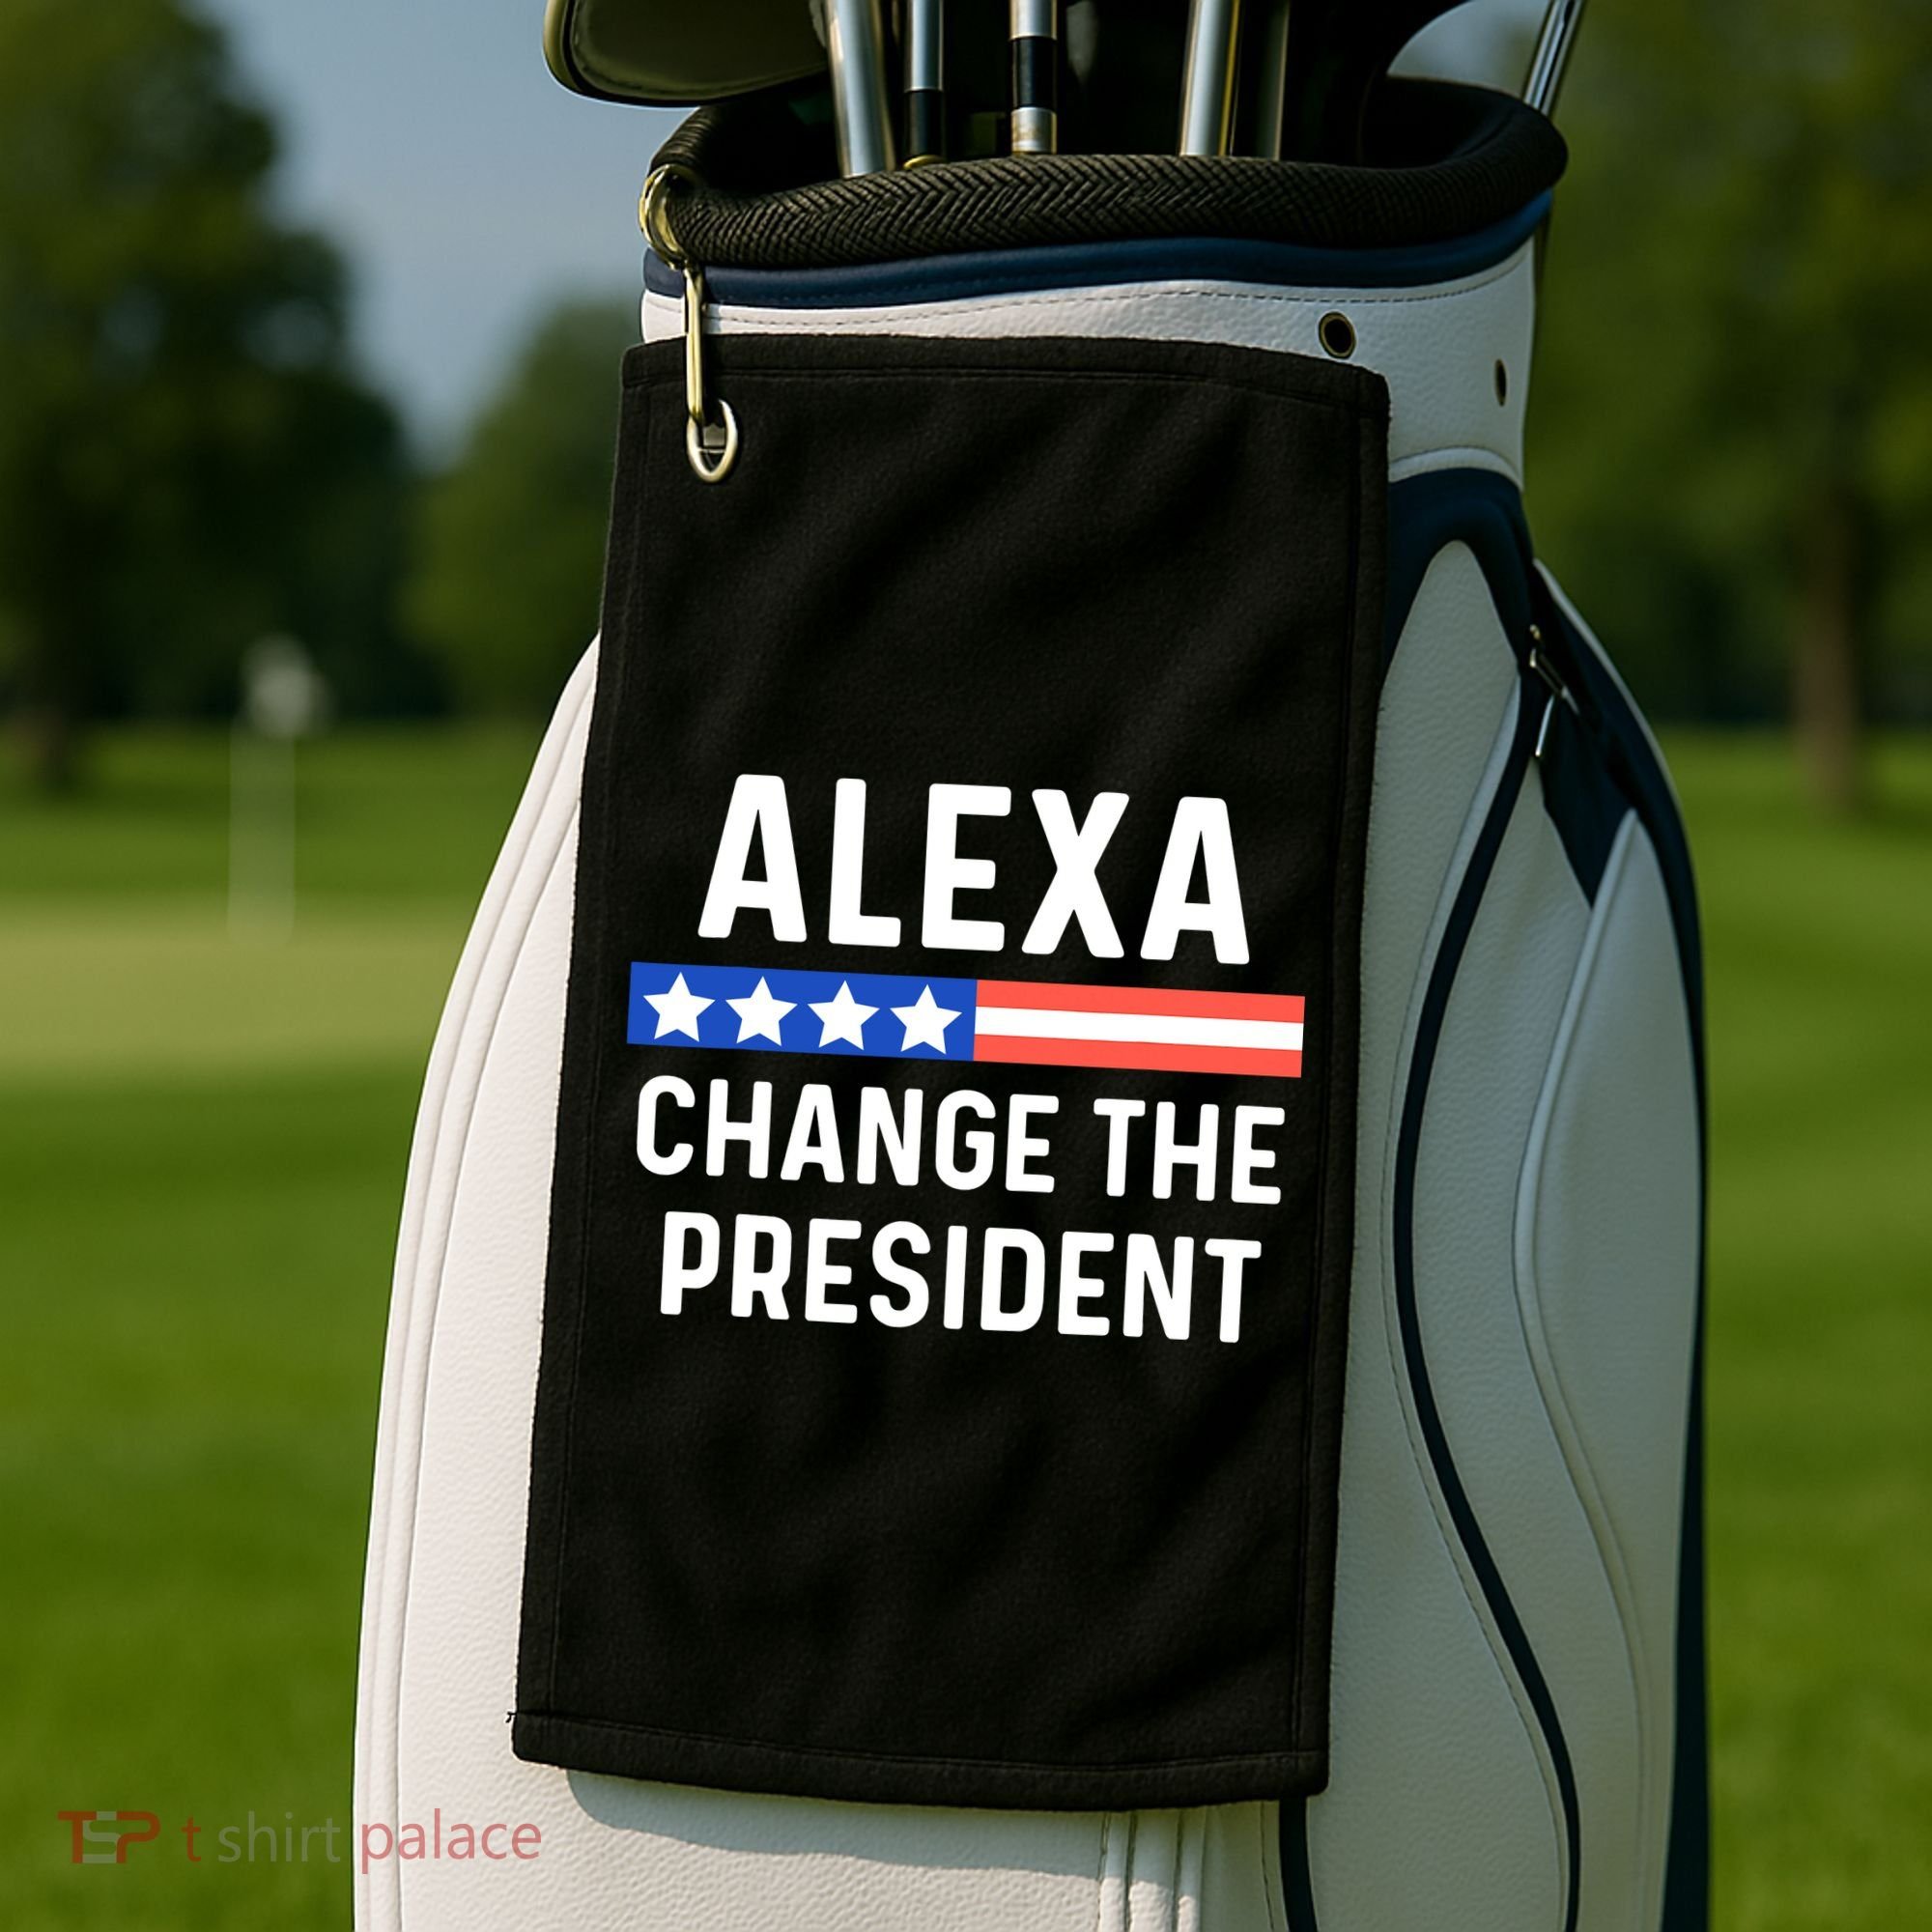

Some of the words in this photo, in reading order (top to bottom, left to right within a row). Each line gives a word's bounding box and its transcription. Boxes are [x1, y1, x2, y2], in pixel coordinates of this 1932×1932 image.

[697, 774, 1250, 965] ALEXA
[636, 1075, 1060, 1194] CHANGE
[1093, 1097, 1286, 1206] THE
[660, 1210, 1262, 1344] PRESIDENT
